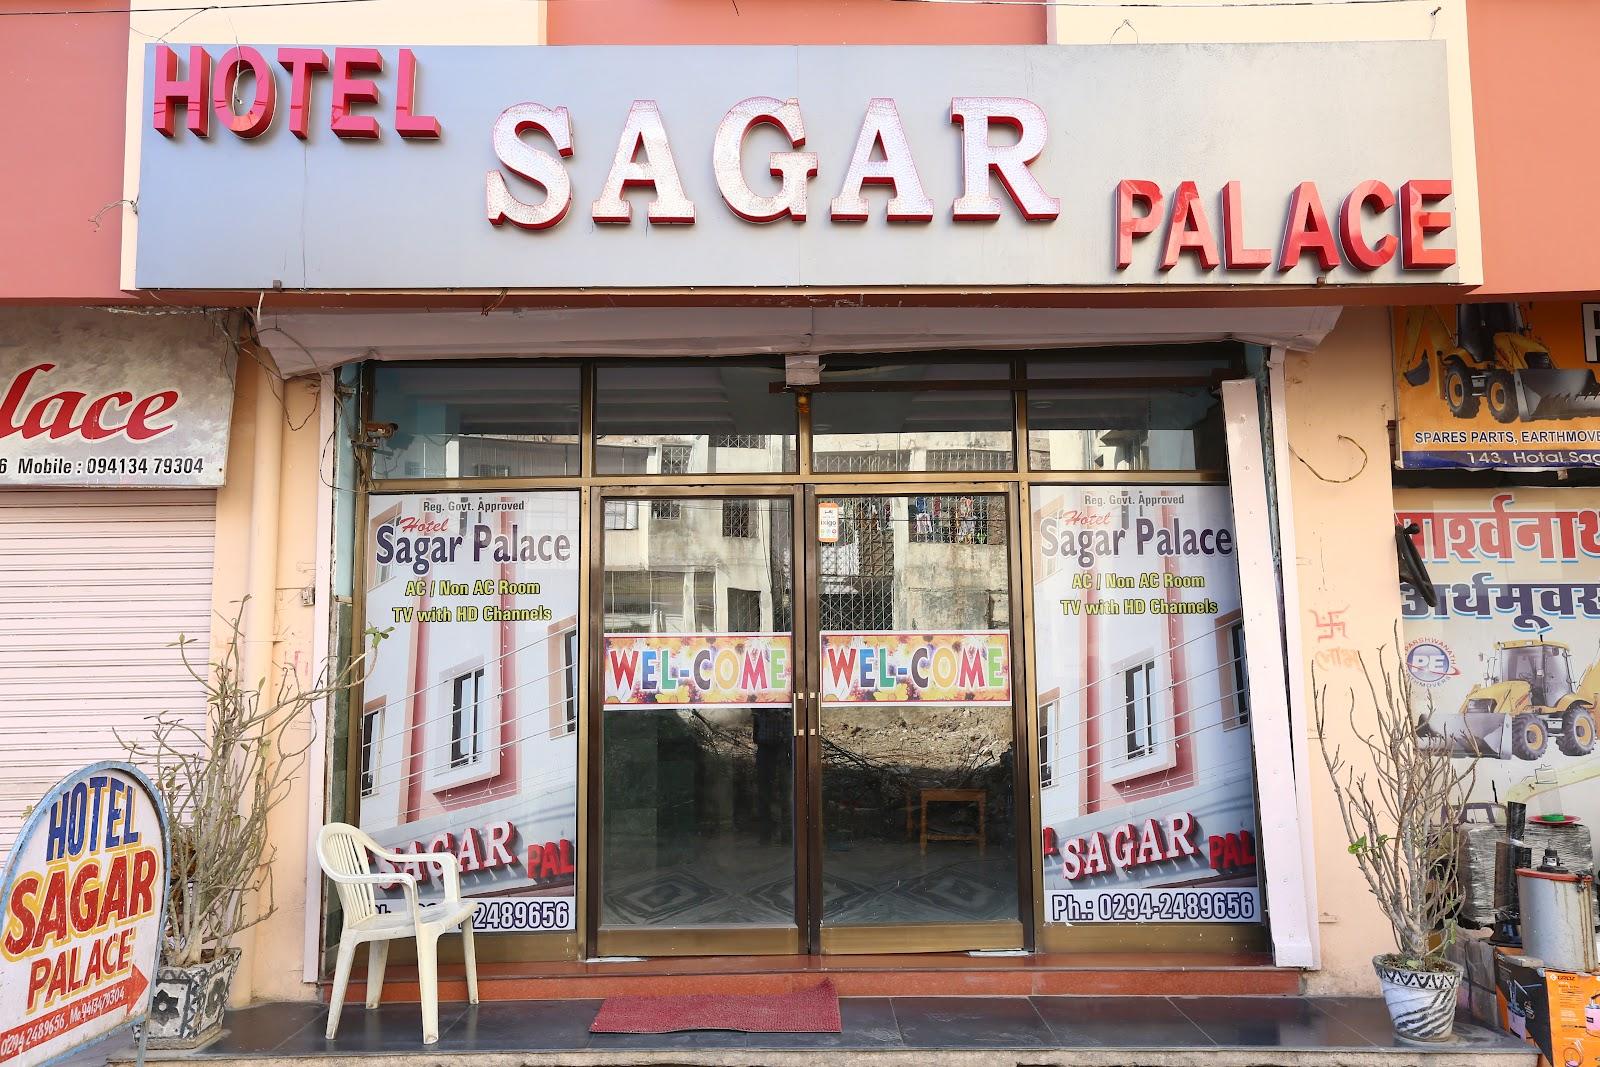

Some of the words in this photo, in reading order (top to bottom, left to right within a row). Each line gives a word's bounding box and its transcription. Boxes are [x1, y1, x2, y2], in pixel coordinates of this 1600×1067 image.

[153, 45, 441, 141] HOTEL
[486, 96, 1061, 231] SAGAR
[1114, 179, 1456, 272] PALACE
[1415, 431, 1467, 443] SPARES
[1471, 430, 1518, 445] PARTS,
[18, 458, 72, 474] Mobile
[87, 458, 148, 474] 094134
[154, 458, 204, 474] 79304
[1513, 451, 1564, 464] Hotal
[423, 501, 445, 513] Reg.
[448, 500, 474, 511] Govt.
[478, 500, 525, 512] Approved
[1062, 510, 1112, 526] Hotel
[1084, 495, 1106, 507] Reg.
[1109, 494, 1135, 505] Govt.
[1139, 494, 1185, 507] Approved
[400, 516, 449, 533] Hotel
[376, 524, 464, 576] Sagar
[473, 524, 571, 563] Palace
[1040, 517, 1126, 568] Sagar
[1136, 517, 1232, 556] Palace
[405, 581, 426, 597] AC
[439, 580, 469, 596] Non
[473, 579, 495, 595] AC
[498, 579, 541, 595] Room
[1072, 574, 1093, 589] AC
[1106, 573, 1134, 589] Non
[1139, 572, 1160, 588] AC
[1164, 573, 1205, 588] Room
[392, 606, 414, 622] TV
[417, 606, 452, 622] with
[456, 606, 478, 621] HD
[483, 605, 552, 621] Channels
[1060, 600, 1081, 616] TV
[1085, 599, 1119, 615] with
[1124, 599, 1145, 615] HD
[1150, 598, 1218, 615] Channels
[609, 648, 787, 691] WEL-COME
[827, 647, 1004, 691] WEL-COME
[46, 776, 141, 862] HOTEL
[527, 838, 574, 879] PAL
[1063, 811, 1200, 881] SAGAR
[1208, 830, 1256, 870] PAL
[3, 849, 158, 956] SAGAR
[1099, 892, 1254, 921] 0294-2489656
[26, 930, 134, 1012] PALACE
